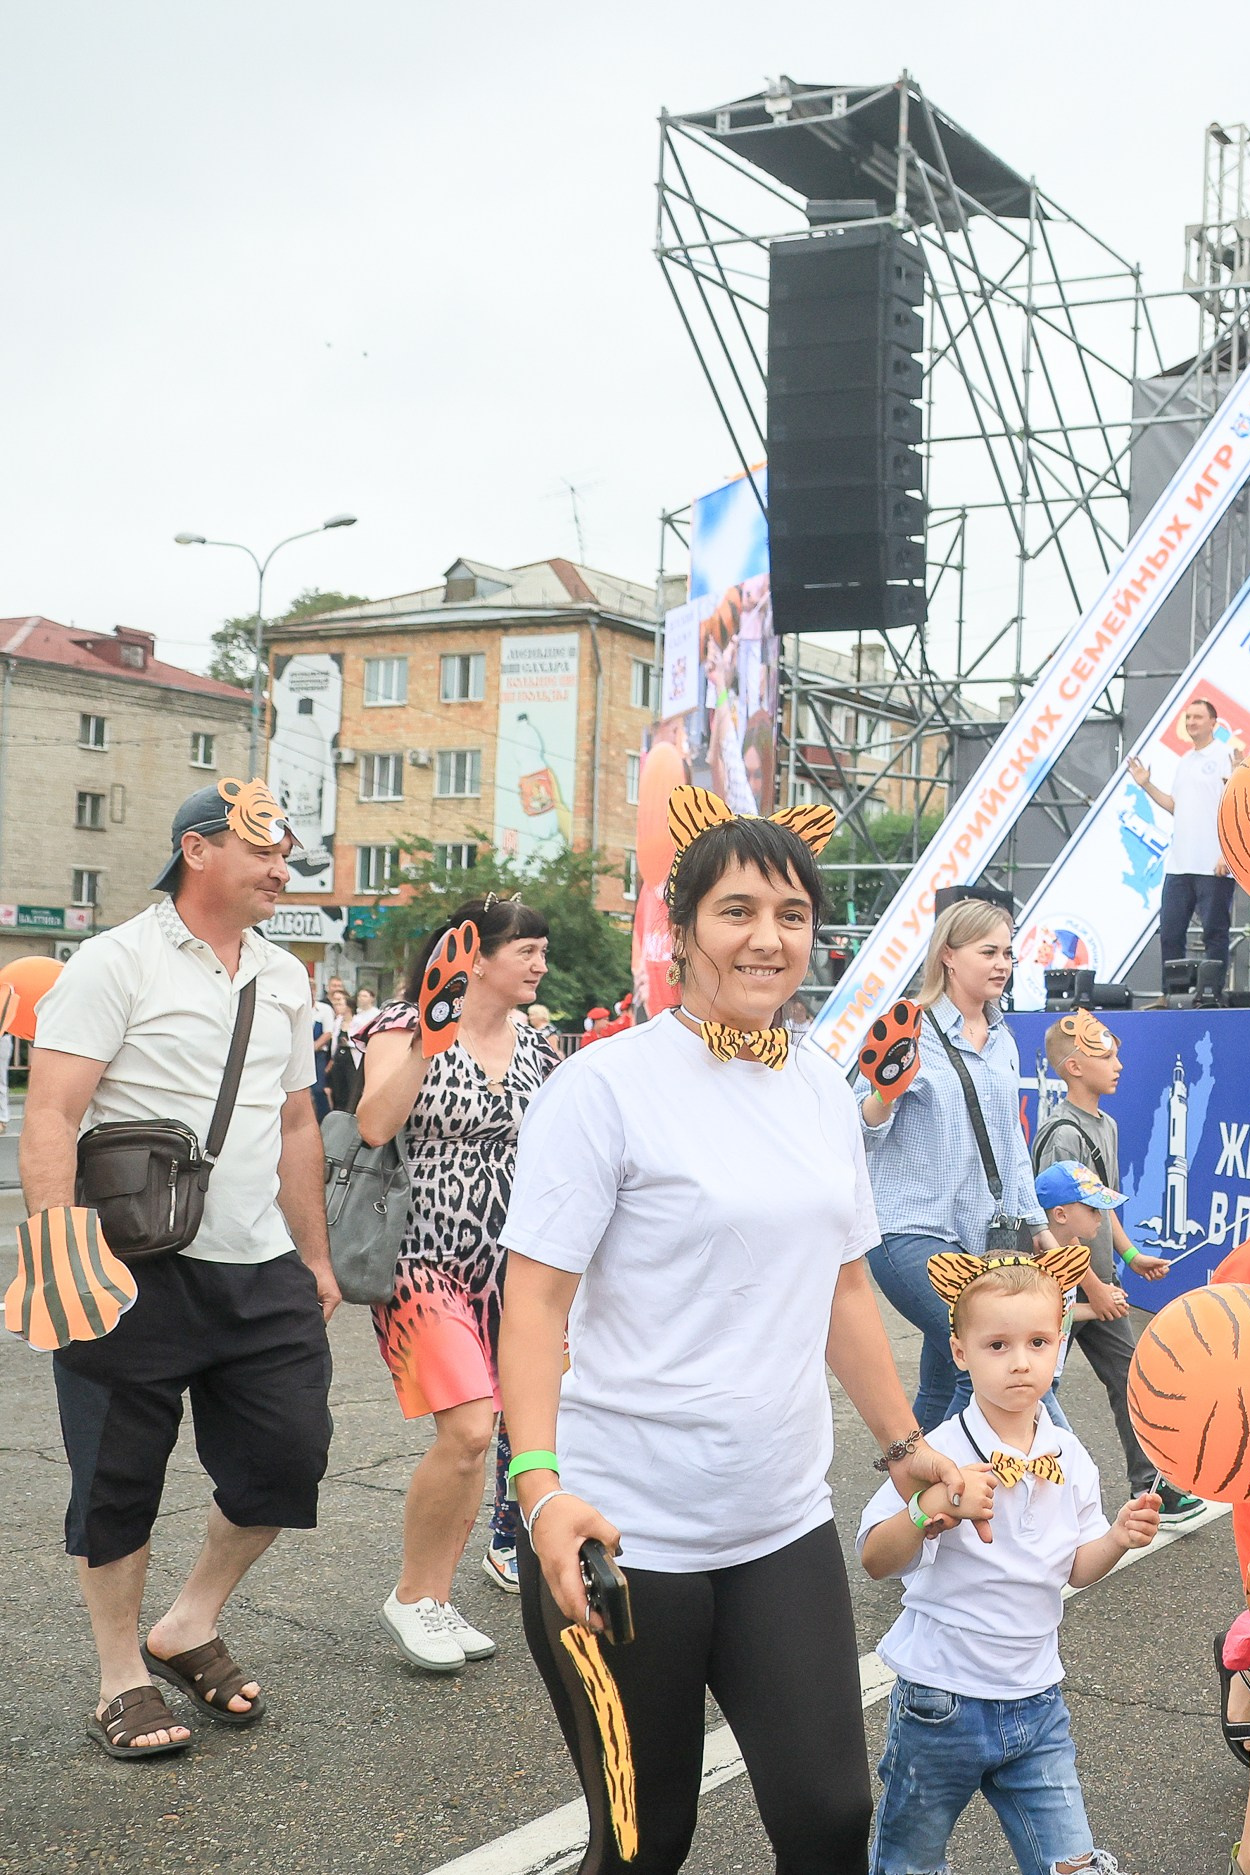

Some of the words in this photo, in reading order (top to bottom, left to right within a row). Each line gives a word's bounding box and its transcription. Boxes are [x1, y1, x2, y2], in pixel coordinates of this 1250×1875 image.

[902, 704, 1063, 936] УССУРИЙСКИХ
[1058, 514, 1192, 702] СЕМЕЙНЫХ
[1185, 444, 1234, 512] ИГР
